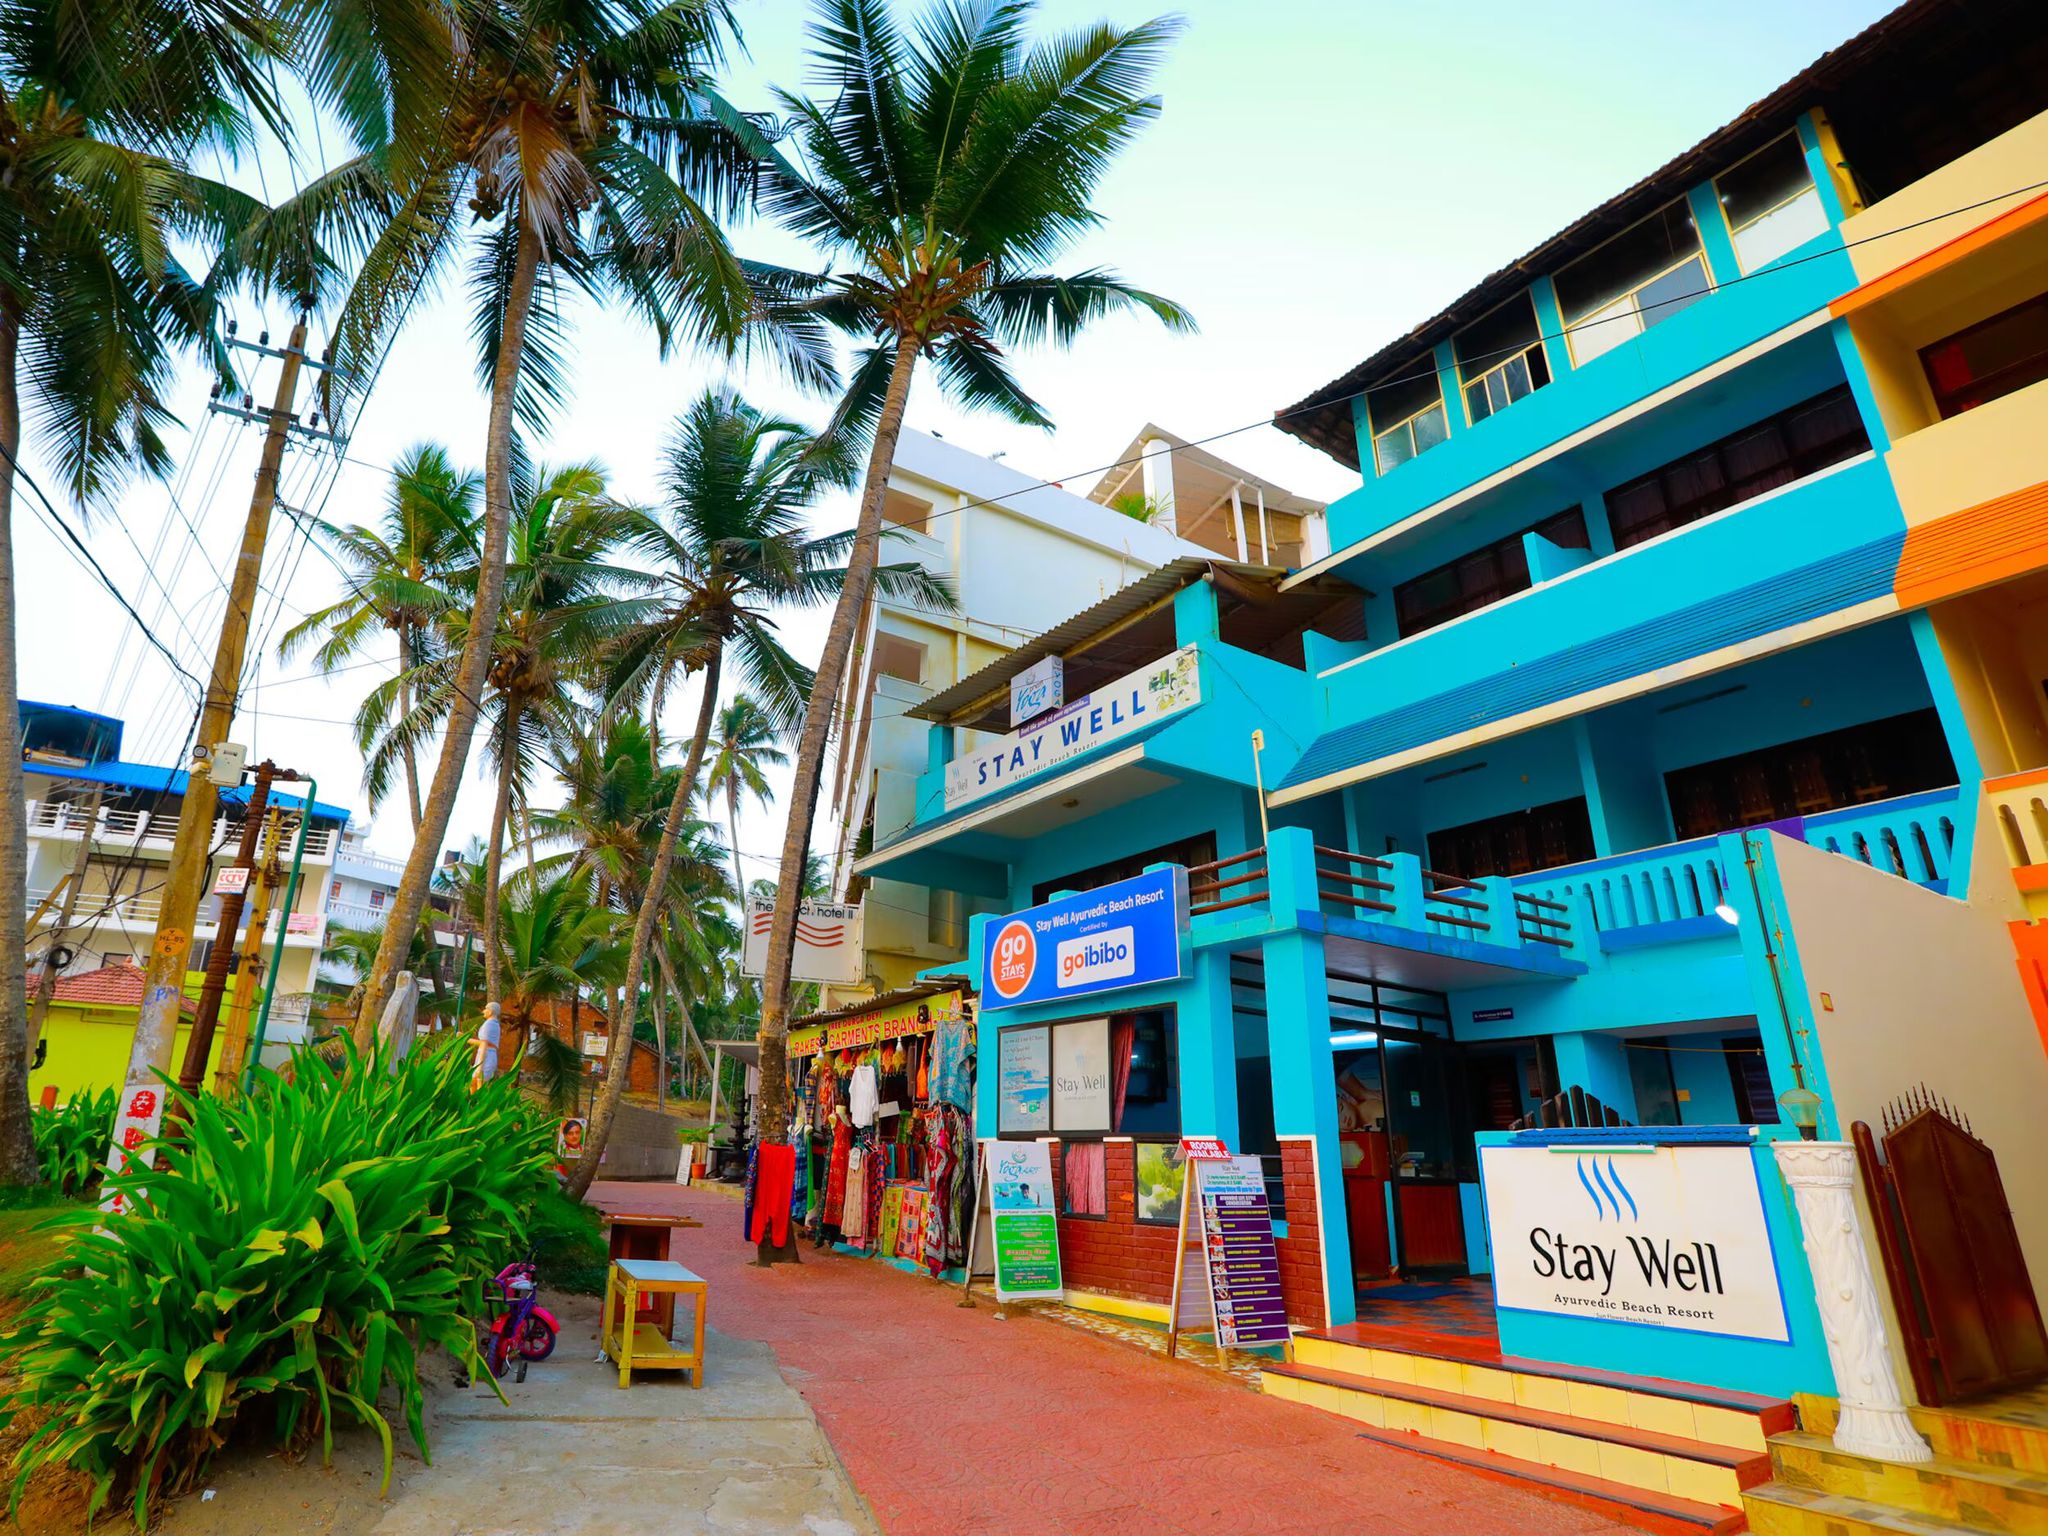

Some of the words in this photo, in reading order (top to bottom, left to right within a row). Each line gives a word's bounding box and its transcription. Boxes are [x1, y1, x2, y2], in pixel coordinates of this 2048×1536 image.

[1015, 684, 1047, 720] Yoga
[1053, 670, 1062, 707] YOGA
[978, 735, 1044, 785] STAY
[1061, 690, 1145, 747] WELL
[220, 873, 246, 882] CCTV
[755, 901, 774, 912] the
[817, 907, 845, 919] hotel
[1036, 918, 1052, 933] Stay
[1052, 911, 1069, 927] Well
[1070, 902, 1108, 925] Ayurvedic
[1109, 895, 1134, 913] Beach
[1135, 887, 1164, 907] Resort
[1080, 922, 1101, 933] Certified
[1001, 934, 1027, 967] go
[1063, 941, 1127, 978] goibibo
[1000, 962, 1026, 979] STAYS
[794, 1034, 823, 1057] RAKES
[828, 1024, 880, 1049] GARMENTS
[1056, 1076, 1081, 1095] Stay
[1082, 1074, 1106, 1090] Well
[1187, 1149, 1231, 1158] AVAILABLE
[1189, 1141, 1219, 1150] ROOMS
[1529, 1226, 1616, 1296] Stay
[1625, 1235, 1724, 1295] Well
[1554, 1292, 1617, 1311] Ayurvedic
[1621, 1300, 1662, 1315] Beach
[1667, 1305, 1715, 1320] Resort
